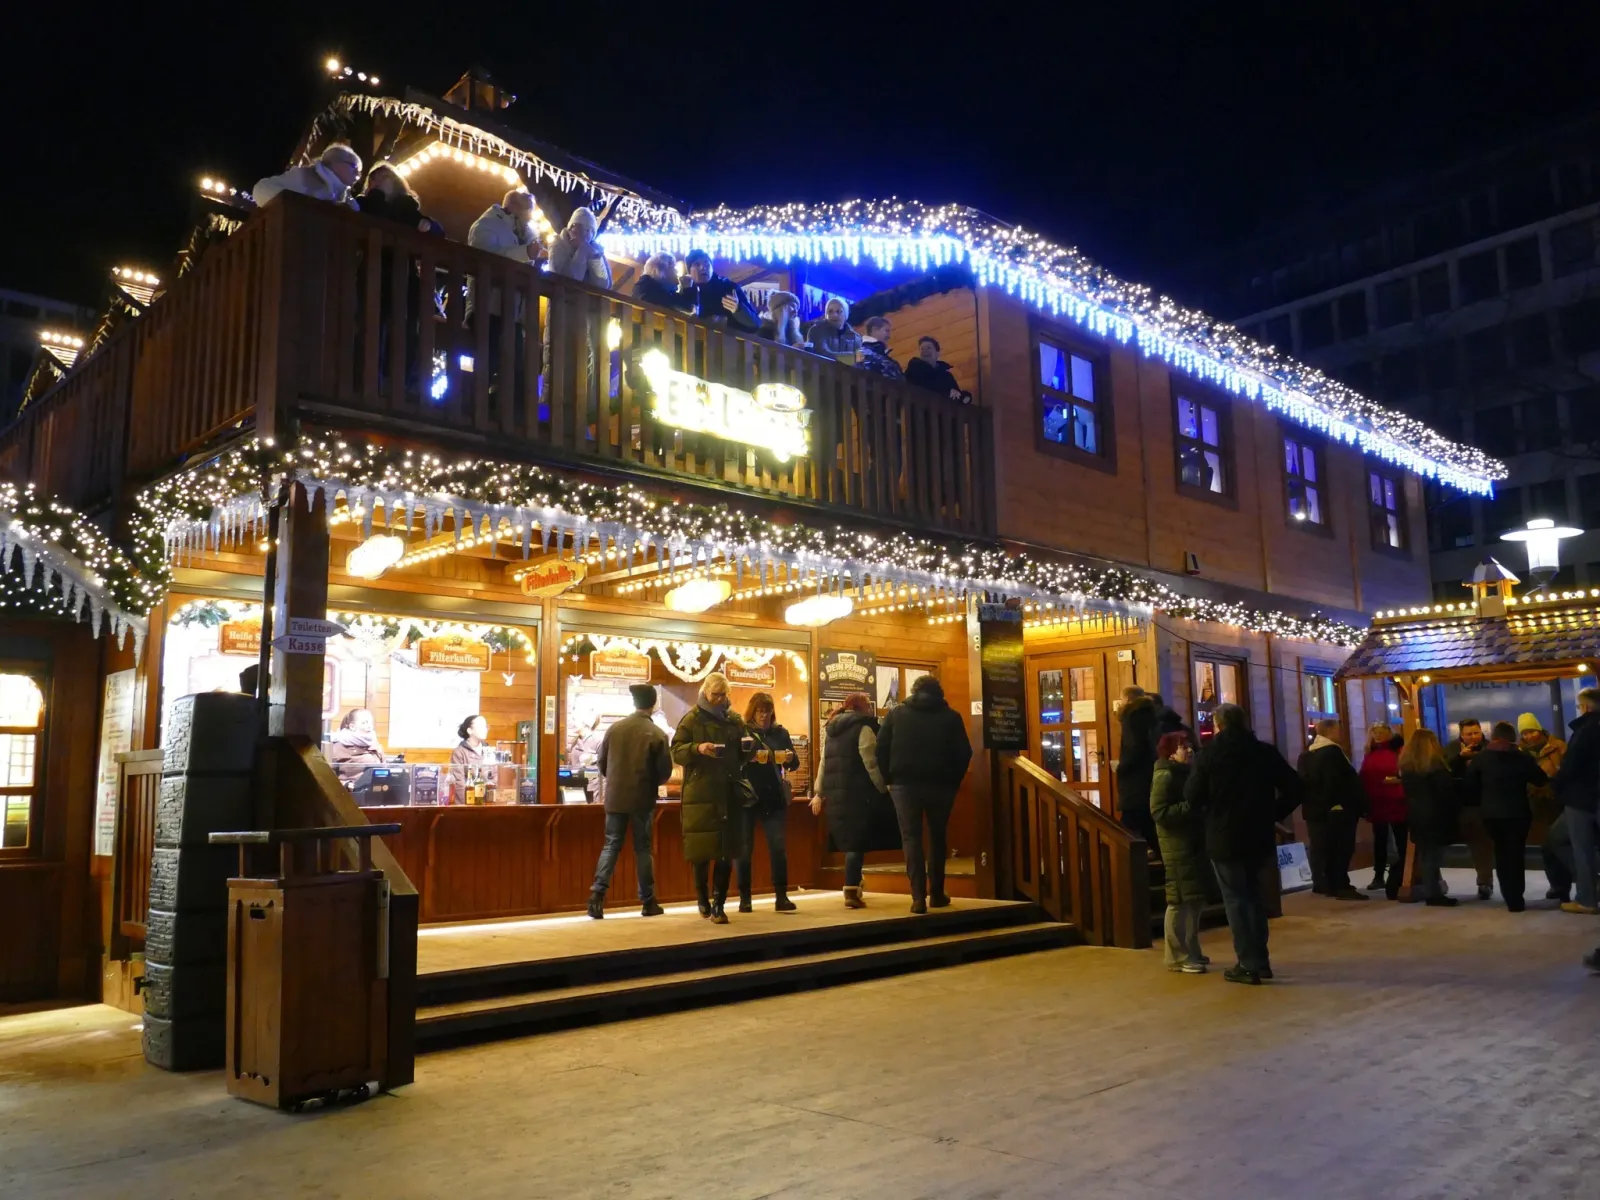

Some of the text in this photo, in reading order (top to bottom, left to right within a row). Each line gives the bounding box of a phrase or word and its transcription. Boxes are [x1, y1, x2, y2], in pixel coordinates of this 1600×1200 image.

[292, 621, 332, 633] Toiletten
[288, 638, 323, 652] Kasse
[430, 651, 480, 665] Filterkaffee
[826, 663, 868, 676] DEIN PFAND
